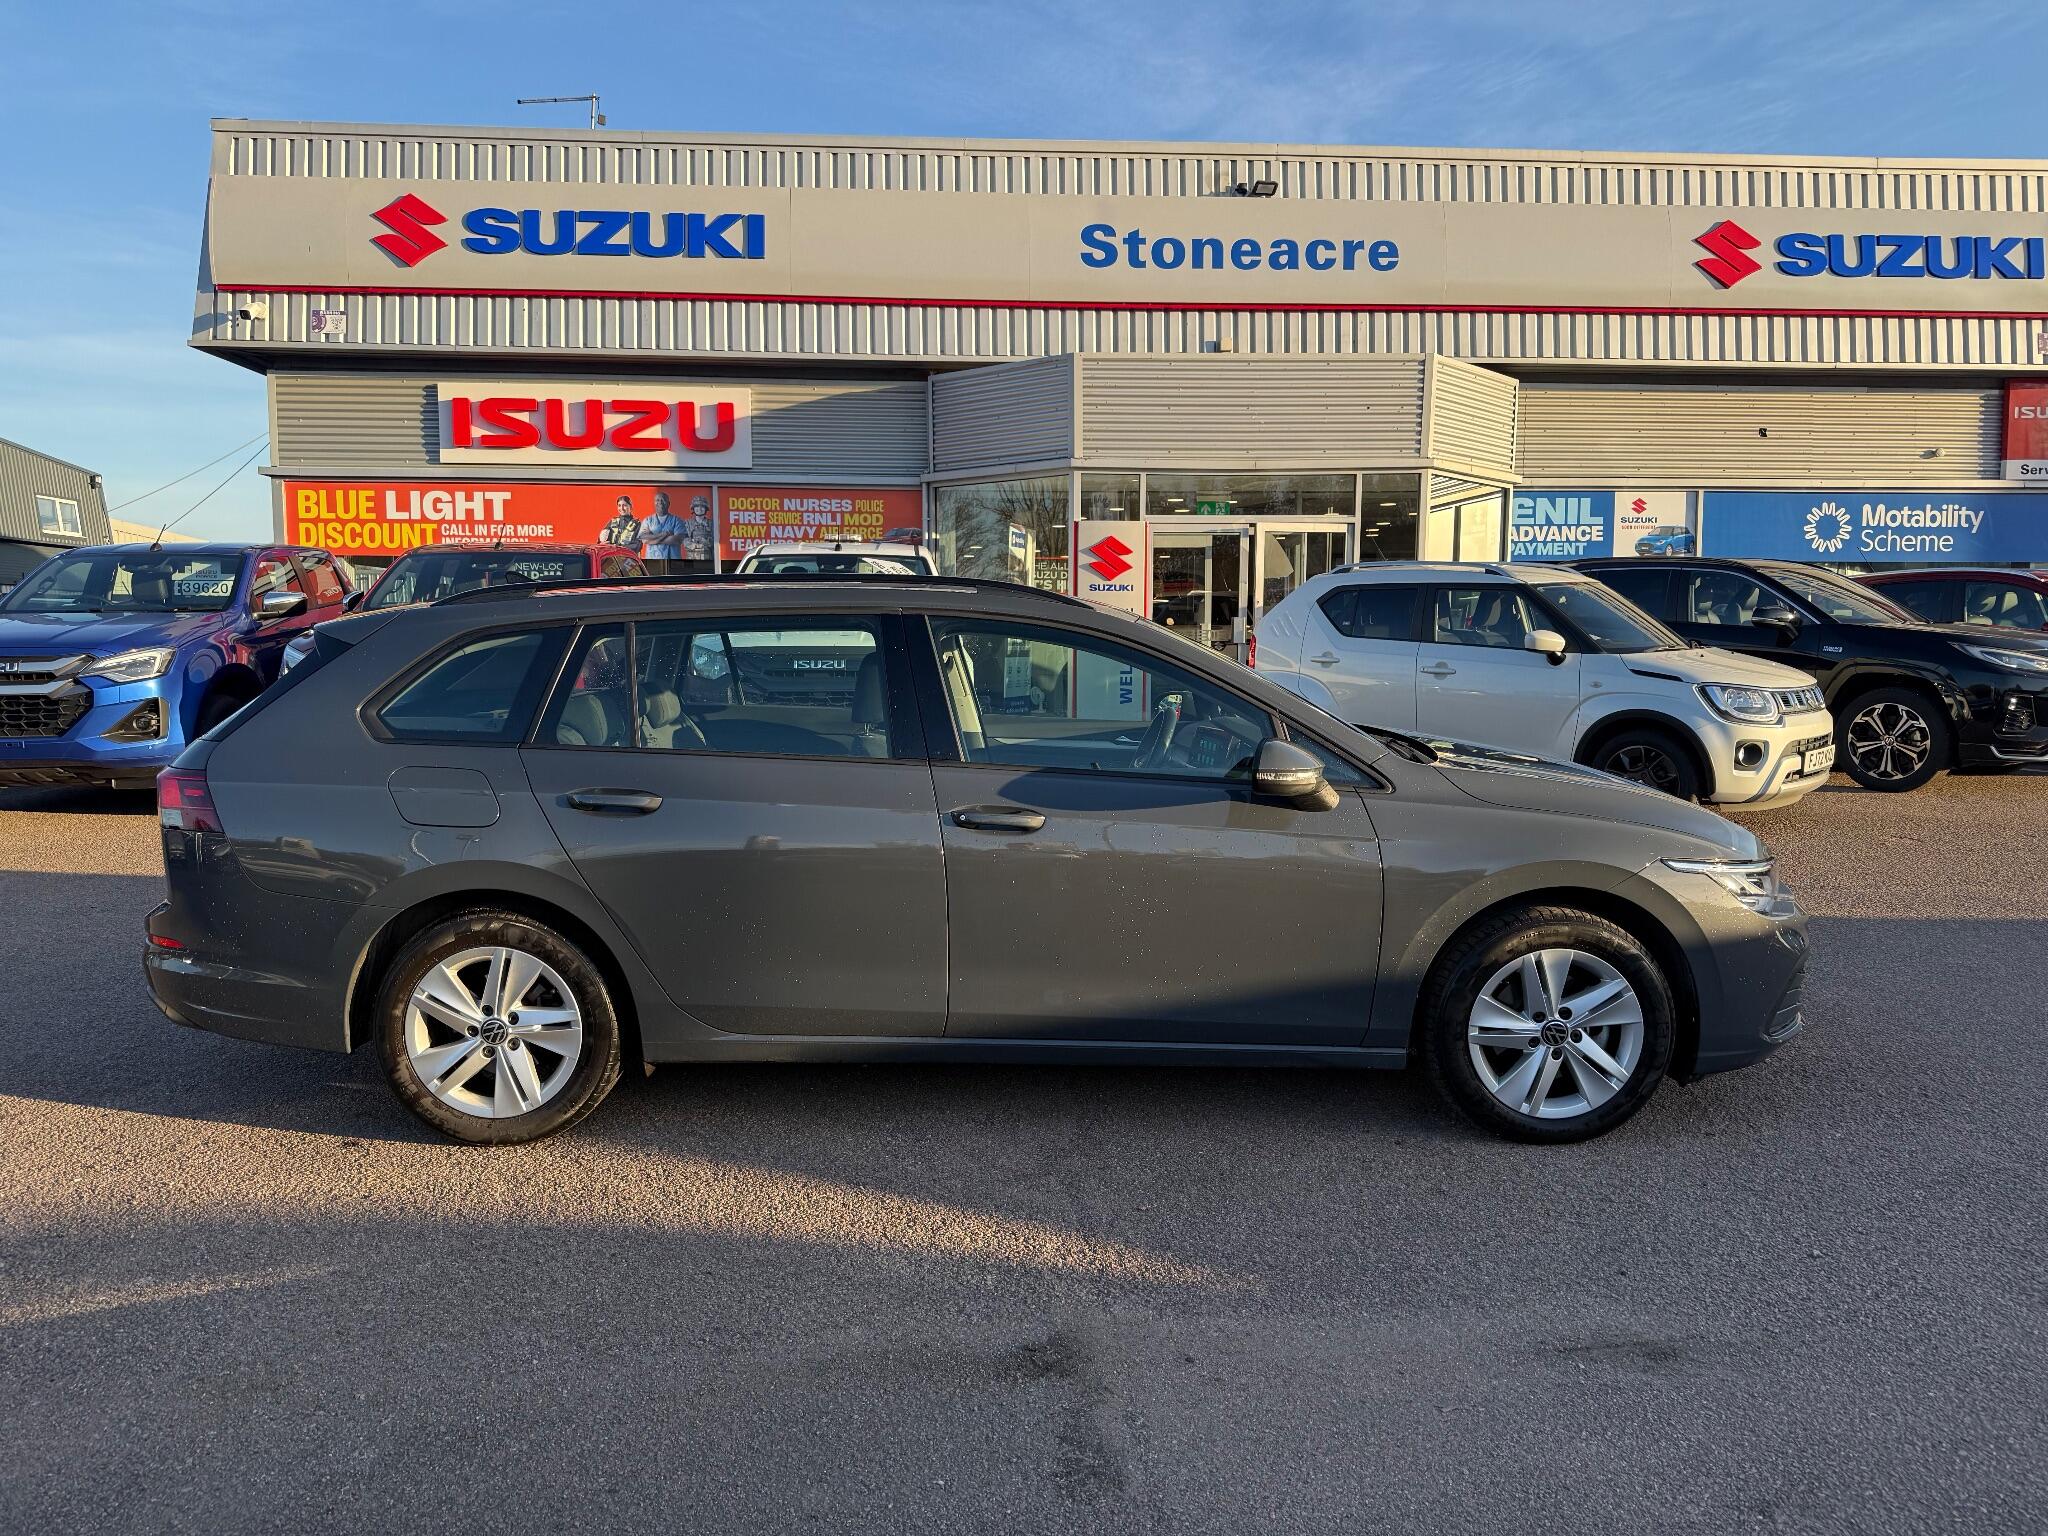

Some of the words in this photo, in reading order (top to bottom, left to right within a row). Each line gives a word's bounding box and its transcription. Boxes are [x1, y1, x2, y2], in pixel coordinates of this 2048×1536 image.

[466, 208, 765, 259] SUZUKI
[1080, 223, 1400, 271] Stoneacre
[1777, 233, 2045, 280] SUZUKI
[451, 397, 735, 453] ISUZU
[297, 489, 377, 519] BLUE
[385, 490, 511, 521] LIGHT
[729, 498, 779, 510] DOCTOR
[783, 498, 852, 512] NURSES
[855, 499, 884, 512] POLICE
[730, 512, 766, 524] FIRE
[769, 512, 802, 525] SERVICE
[803, 513, 841, 525] RNLI
[844, 513, 884, 526] MOD
[1620, 516, 1658, 524] SUZUKI
[1861, 503, 1984, 533] Motability
[299, 522, 437, 549] DISCOUNT
[441, 523, 472, 536] CALL
[475, 524, 487, 536] IN
[491, 524, 514, 537] FOR
[518, 525, 554, 537] MORE
[730, 526, 767, 538] ARMY
[770, 526, 816, 538] NAVY
[843, 527, 883, 539] FORCE
[1510, 526, 1603, 541] ADVANCE
[1860, 529, 1954, 552] Scheme
[1089, 583, 1134, 592] SUZUKI
[793, 660, 846, 670] ISUZU
